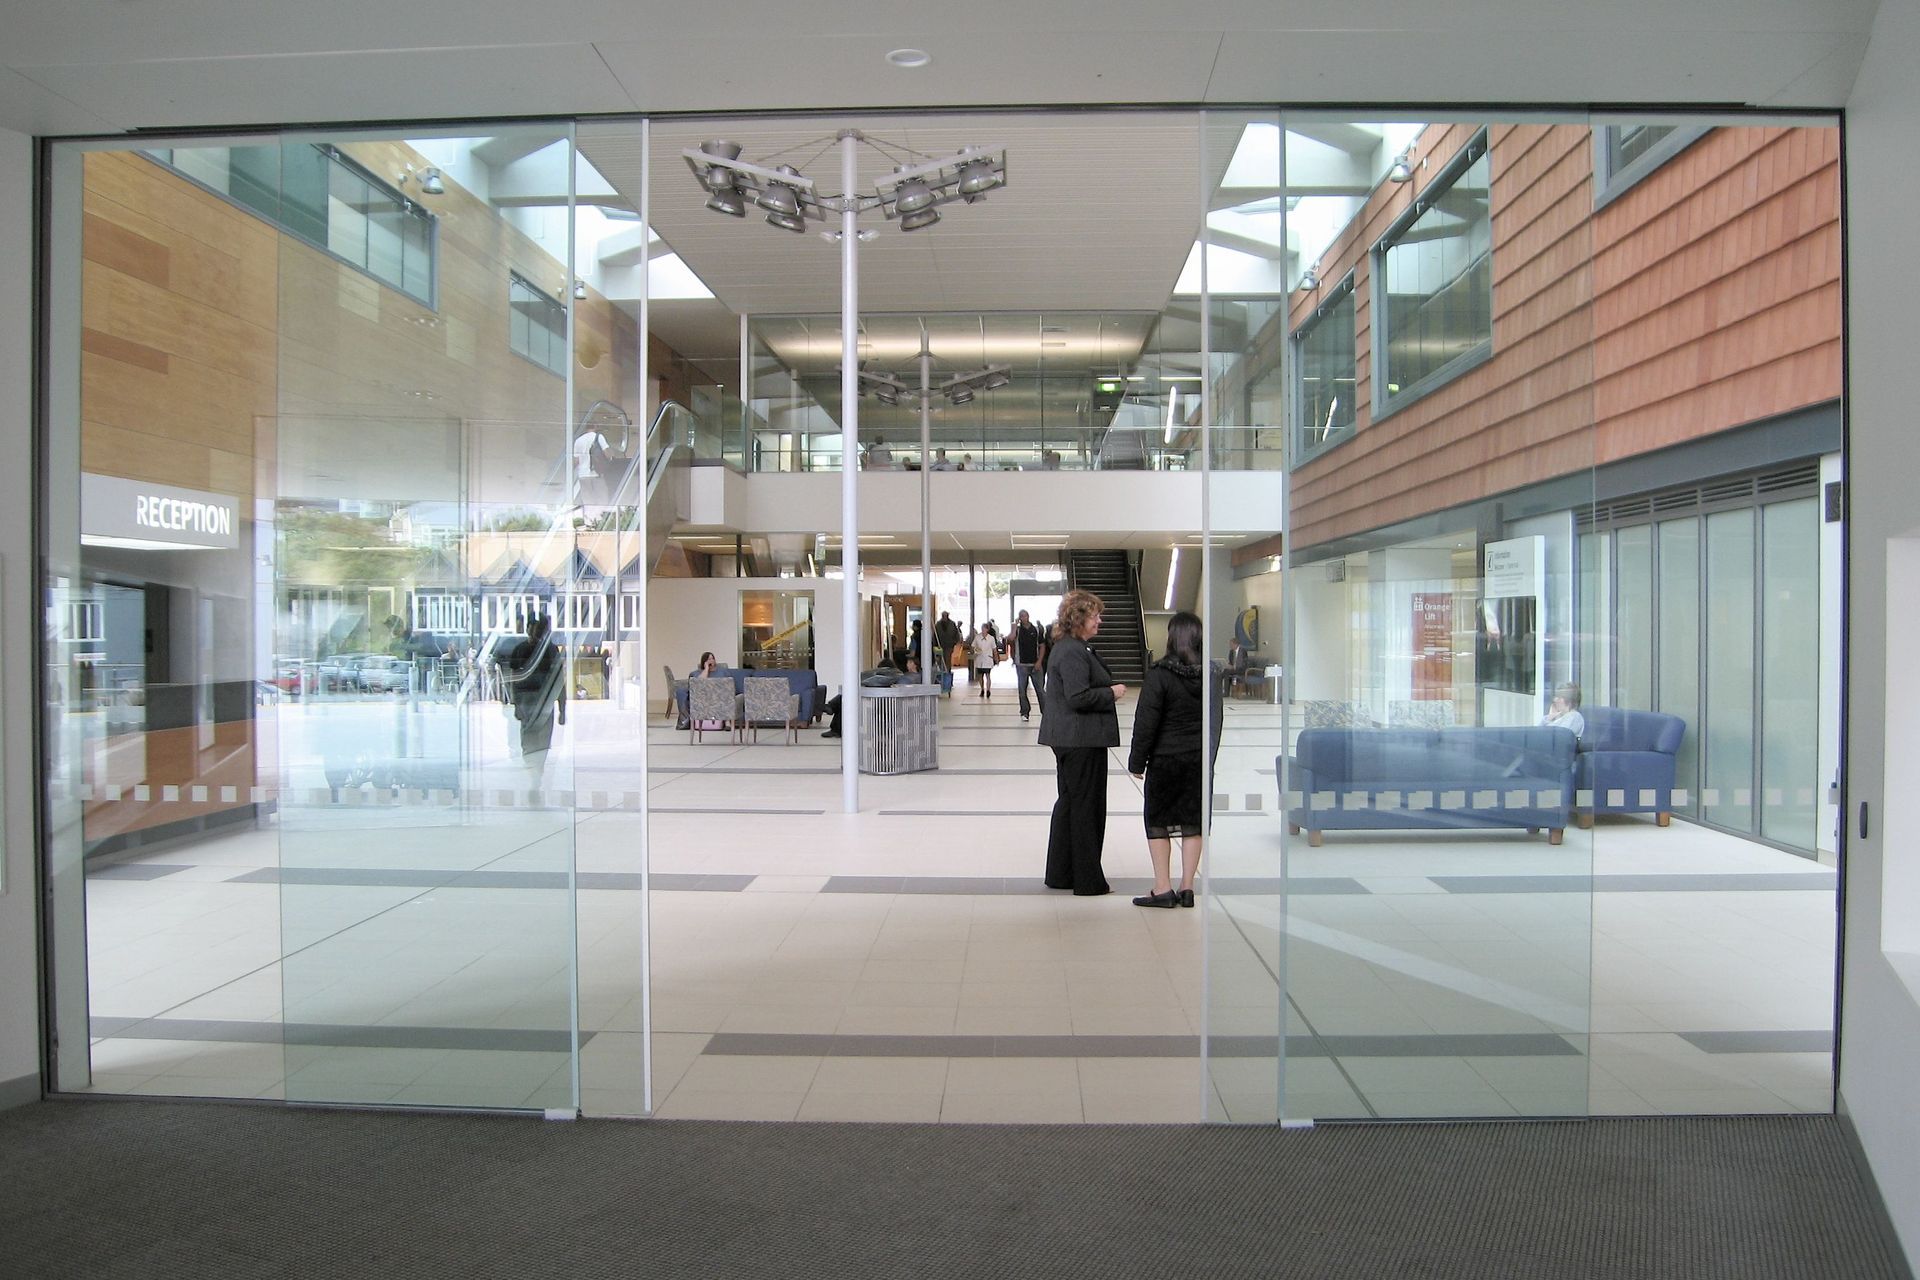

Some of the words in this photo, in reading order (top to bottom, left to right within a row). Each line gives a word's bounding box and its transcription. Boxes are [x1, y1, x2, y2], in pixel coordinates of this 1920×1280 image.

[136, 495, 230, 535] RECEPTION
[1424, 602, 1451, 612] Orange
[1424, 612, 1436, 620] Lift
